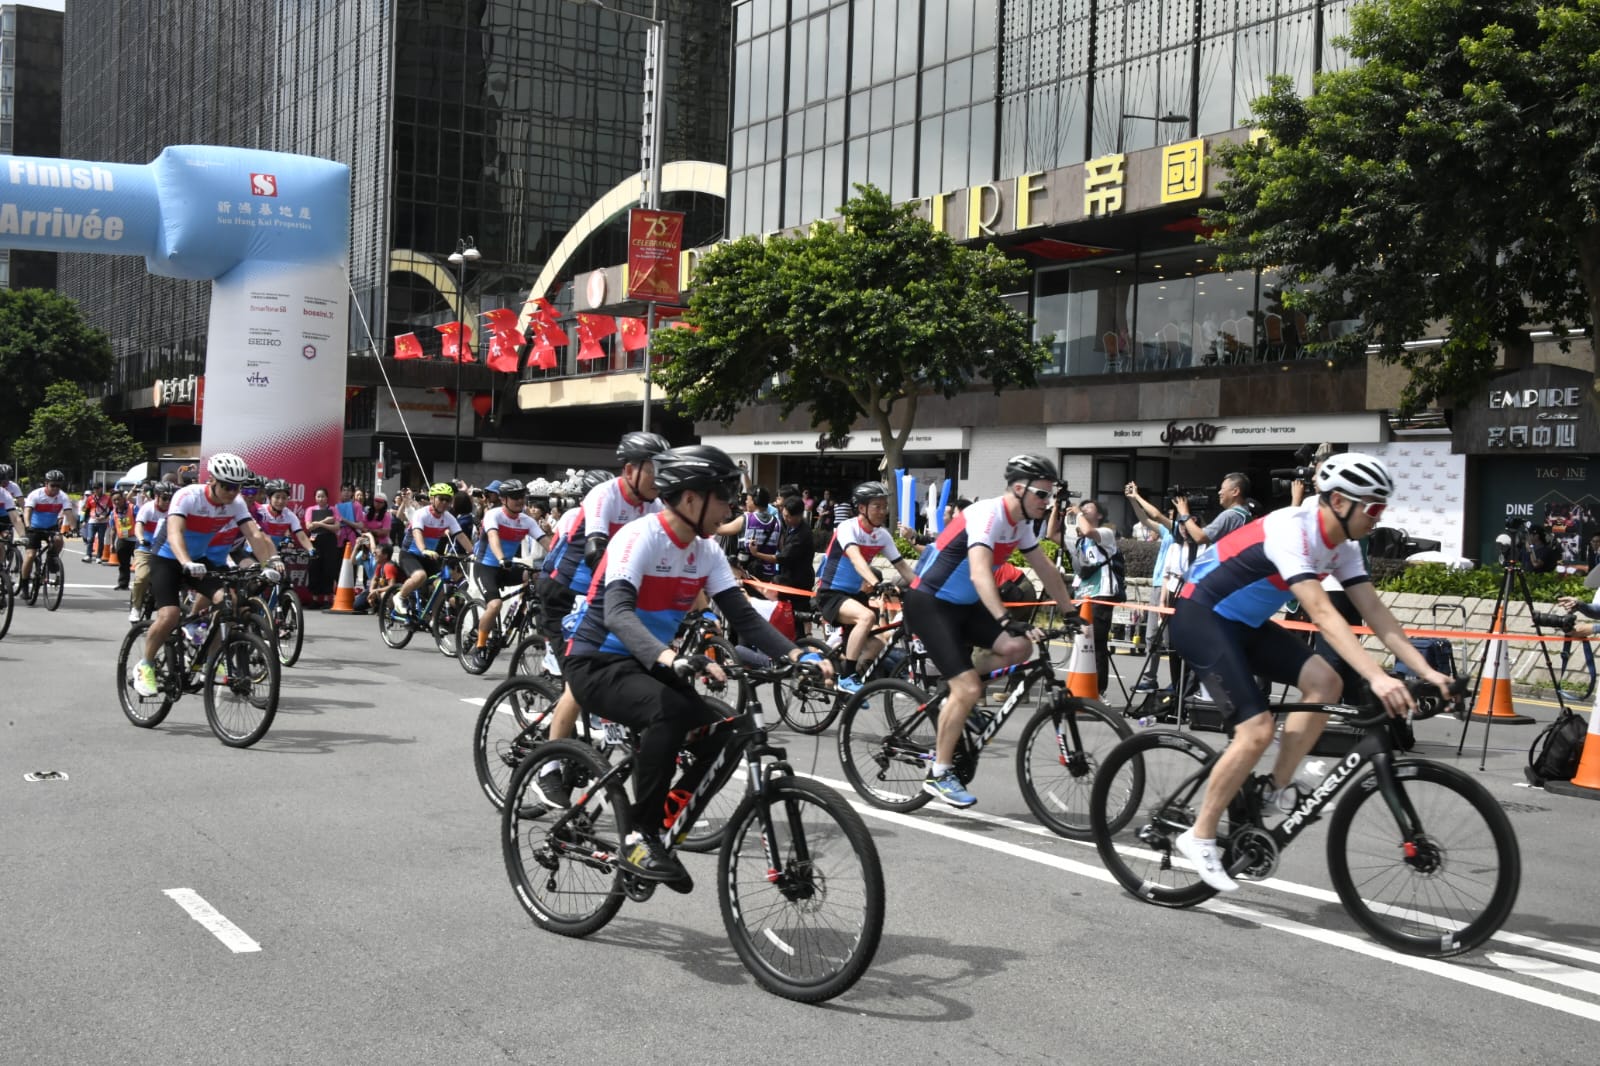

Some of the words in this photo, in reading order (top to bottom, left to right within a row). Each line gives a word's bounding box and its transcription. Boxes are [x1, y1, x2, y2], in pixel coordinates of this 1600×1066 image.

[8, 160, 114, 192] Finish
[0, 203, 124, 240] Arrivée
[643, 216, 668, 239] 75
[248, 338, 282, 347] SEIKO
[1489, 387, 1580, 409] EMPIRE
[1505, 503, 1534, 516] DINE
[1282, 752, 1361, 834] PINARELLO
